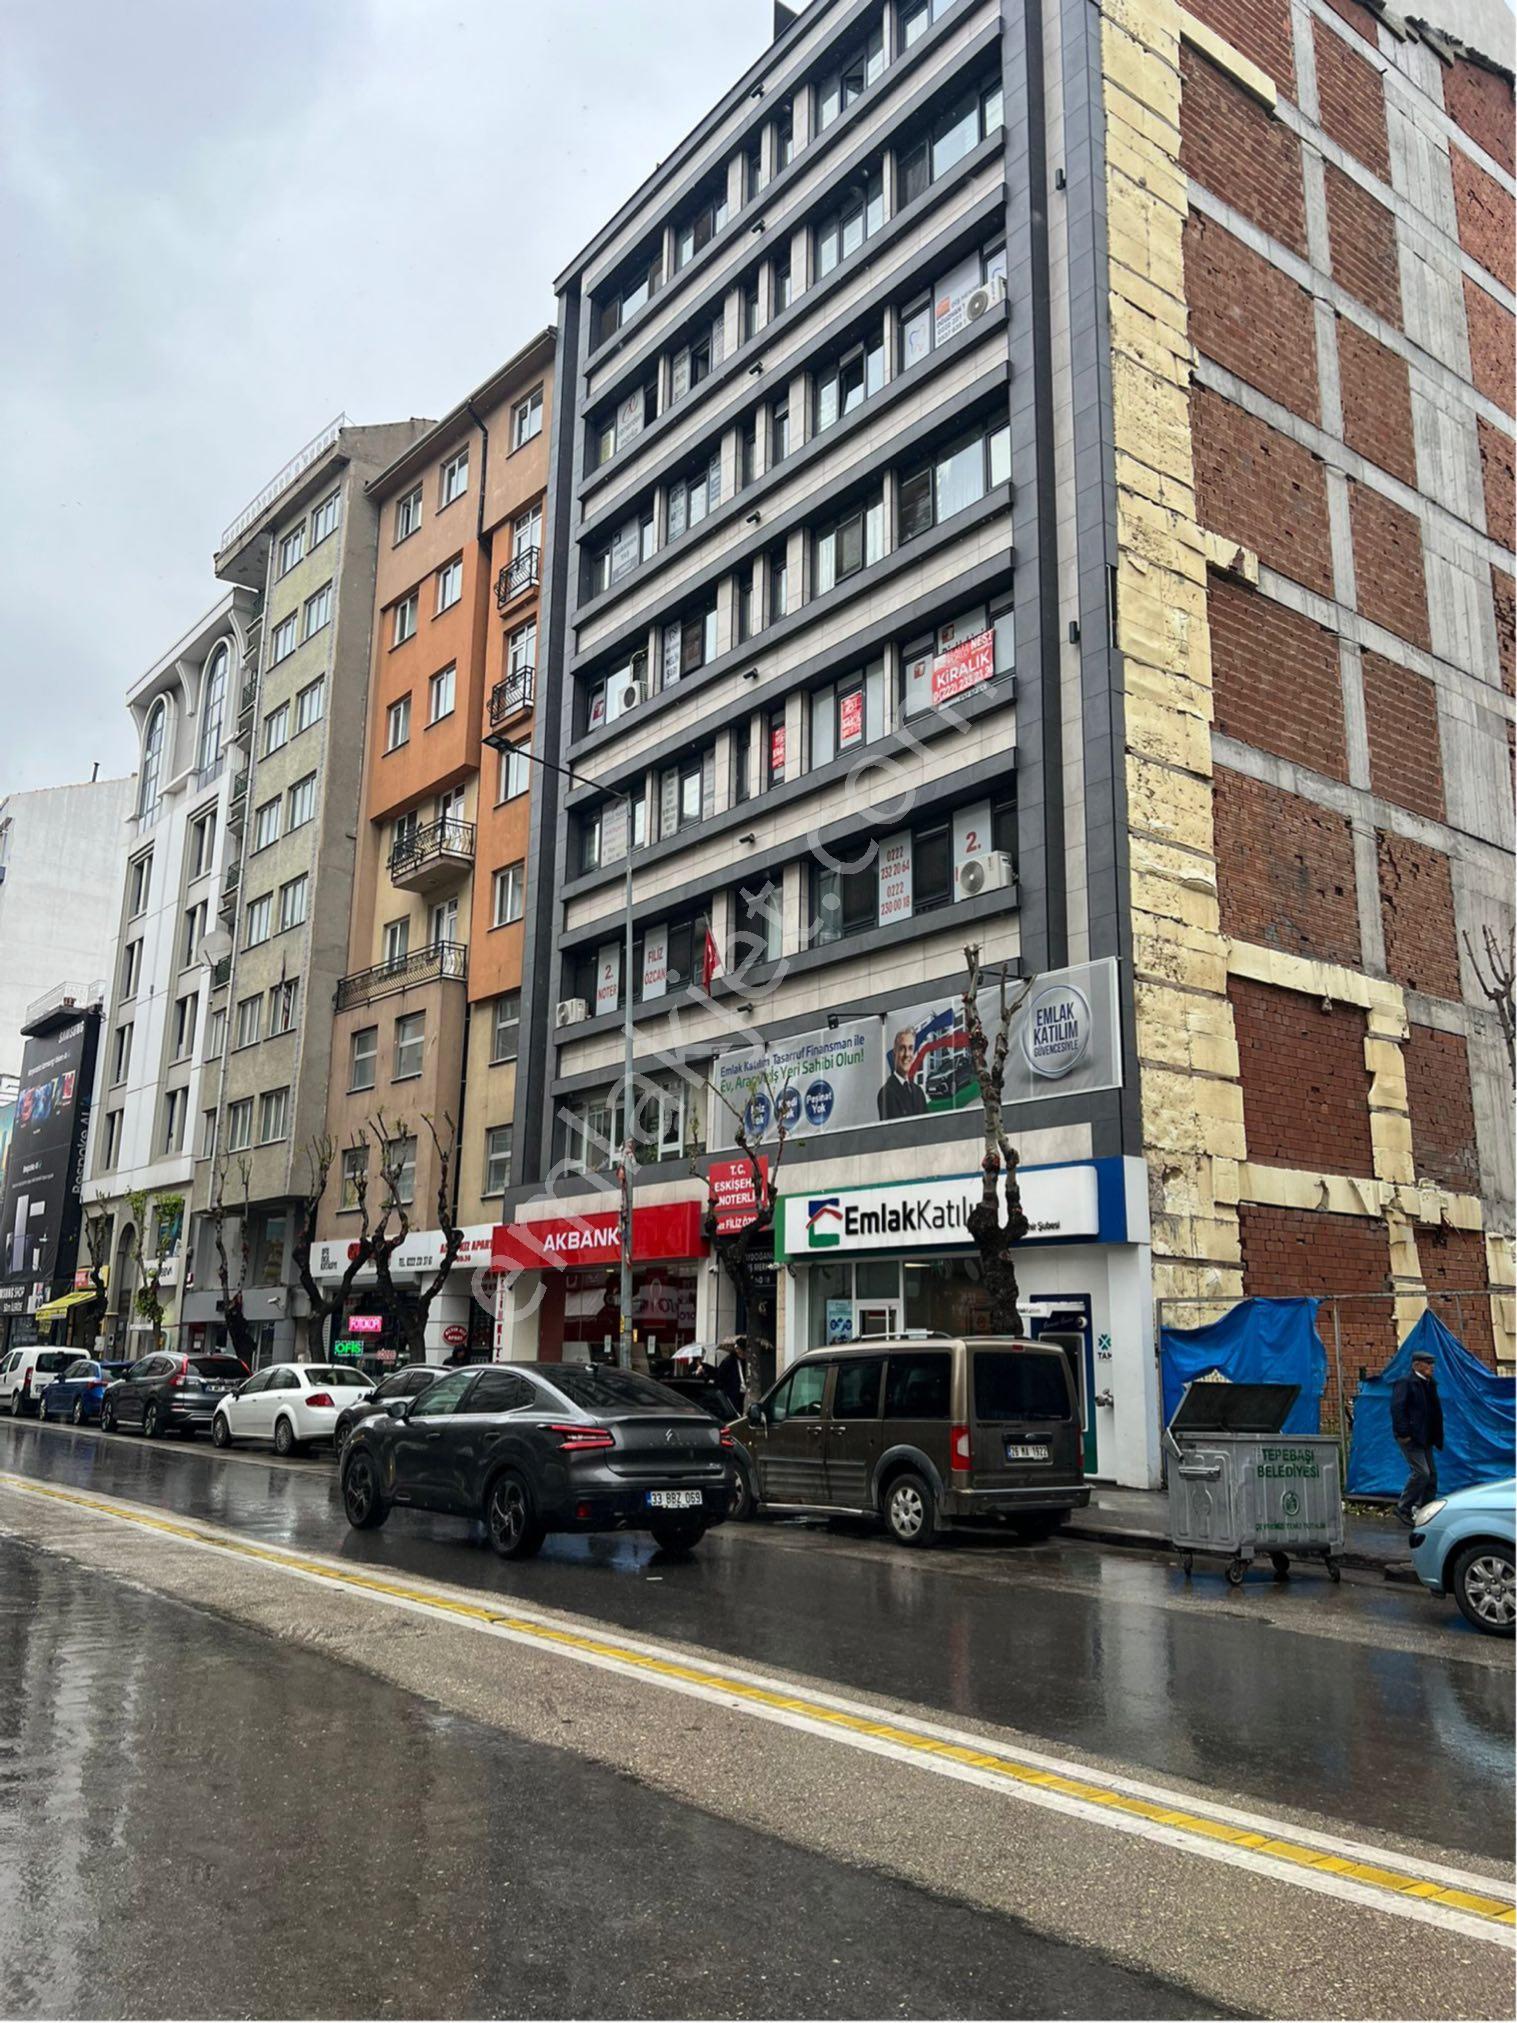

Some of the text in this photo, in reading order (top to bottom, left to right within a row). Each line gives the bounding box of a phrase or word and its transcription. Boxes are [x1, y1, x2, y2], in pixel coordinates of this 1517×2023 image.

[936, 650, 990, 688] KİRALIK
[965, 831, 982, 853] 2.
[886, 846, 904, 862] 0222
[886, 882, 905, 897] 0222
[1036, 1002, 1075, 1026] EMLAK
[1033, 1020, 1079, 1046] KATILIM
[720, 1063, 743, 1077] Emlak
[773, 1049, 805, 1065] Tasarruf
[806, 1040, 853, 1057] Finansman
[854, 1034, 865, 1046] ile
[781, 1062, 801, 1079] Yeri
[802, 1054, 834, 1075] Sahibi
[836, 1048, 865, 1067] Olun!
[811, 1102, 826, 1115] Yok
[729, 1164, 746, 1176] T.C.
[725, 1217, 742, 1230] FİLİZ
[543, 1226, 621, 1252] AKBANK
[1261, 1448, 1315, 1464] TEPEBAŞI
[1257, 1465, 1320, 1478] BELEDİYESİ
